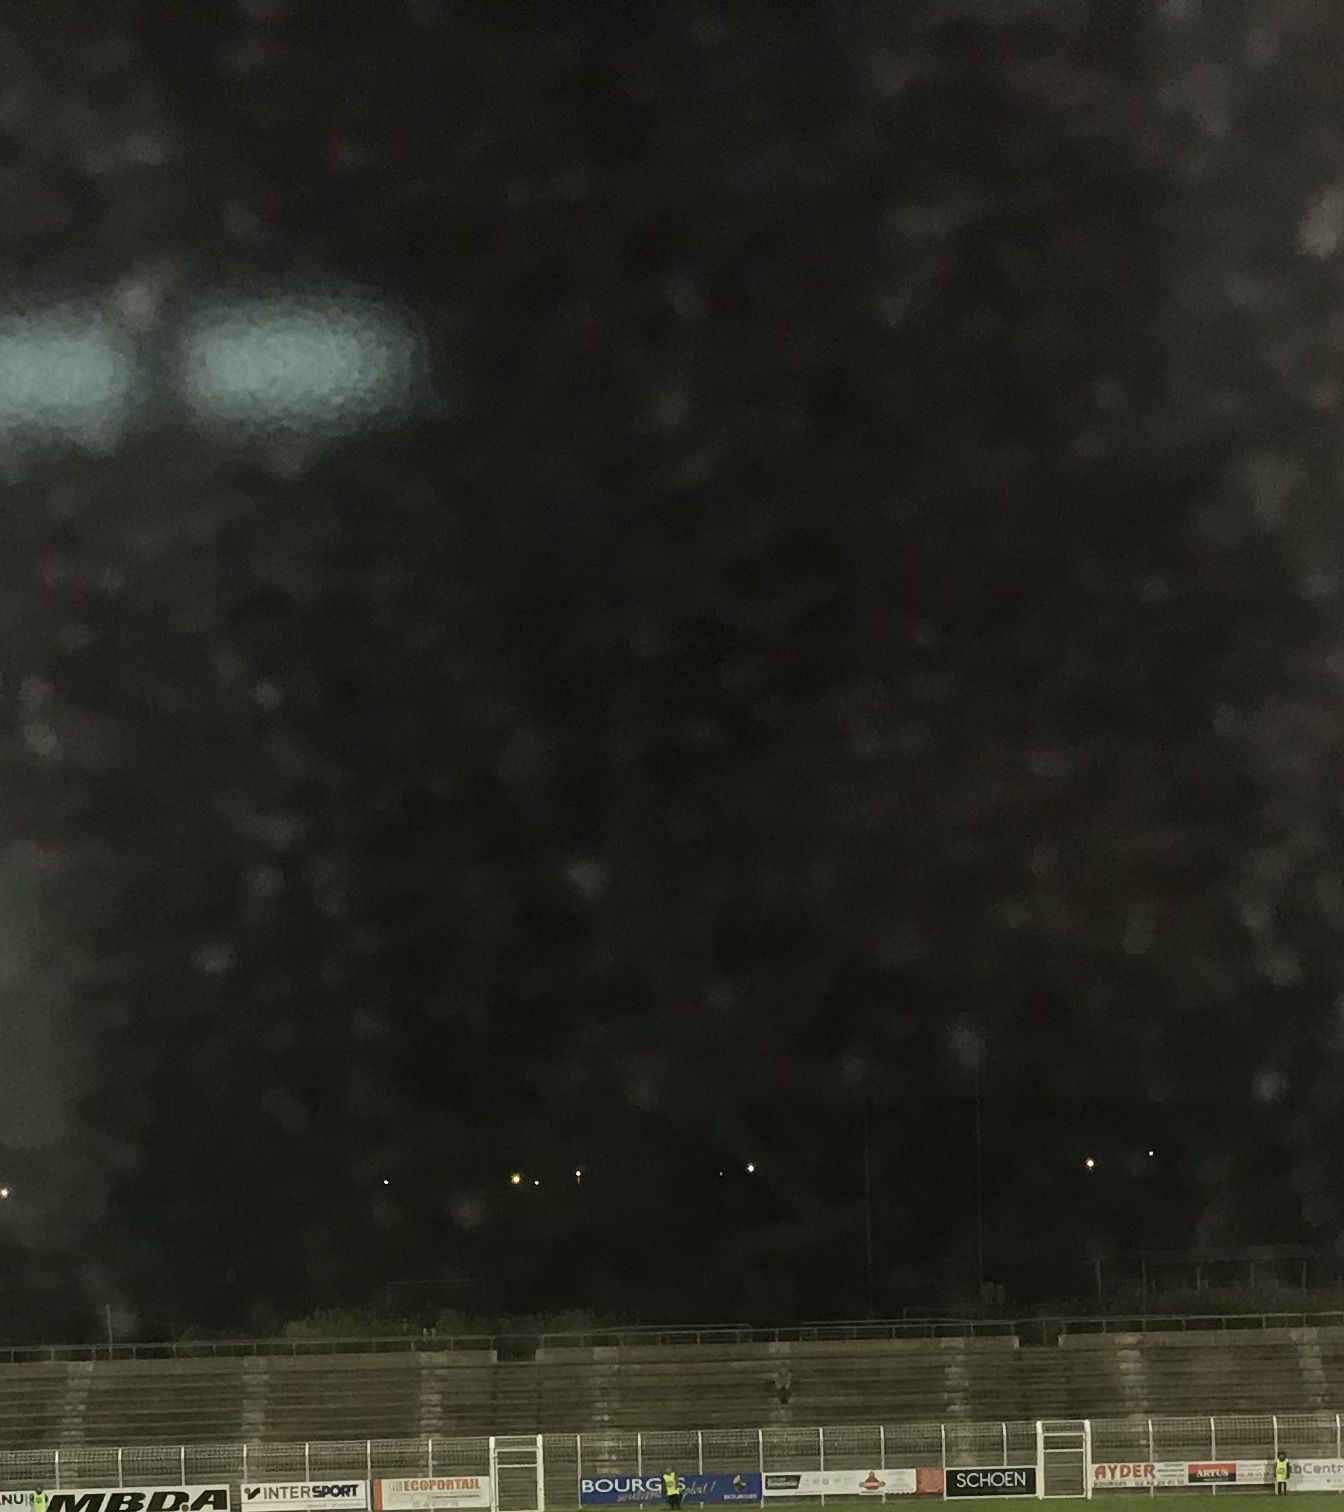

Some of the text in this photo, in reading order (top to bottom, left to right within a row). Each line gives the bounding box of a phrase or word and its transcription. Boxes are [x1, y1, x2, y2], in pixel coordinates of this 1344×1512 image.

[955, 1471, 1027, 1488] SCHOEN
[1093, 1463, 1156, 1480] AYDER
[263, 1483, 359, 1500] INTERSPORT
[581, 1477, 687, 1494] BOURGS
